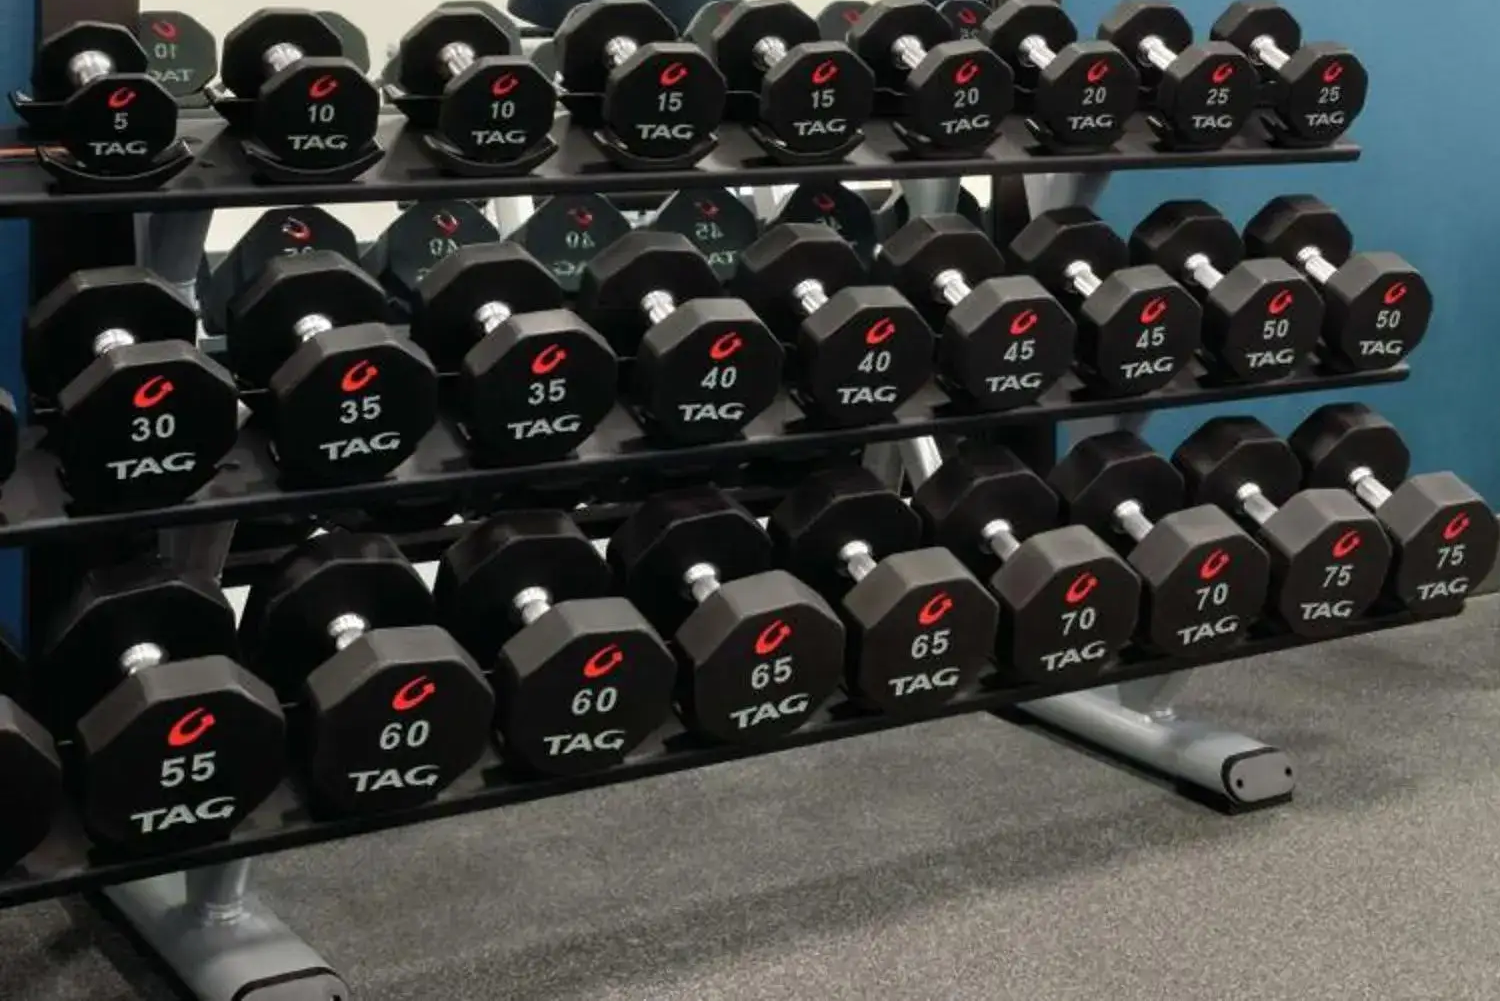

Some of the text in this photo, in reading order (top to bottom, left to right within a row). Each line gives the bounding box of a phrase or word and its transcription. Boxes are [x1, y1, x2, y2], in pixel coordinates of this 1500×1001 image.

[658, 91, 683, 112] 15
[811, 88, 835, 109] 15
[954, 86, 980, 109] 20
[1082, 86, 1107, 106] 20
[1205, 87, 1231, 106] 25
[1317, 85, 1341, 104] 25
[113, 112, 129, 130] 5
[308, 103, 335, 123] 10
[491, 100, 516, 120] 10
[1191, 114, 1233, 129] TAG
[1305, 110, 1345, 127] TAG
[636, 123, 693, 140] TAG
[793, 118, 847, 136] TAG
[940, 114, 991, 135] TAG
[1068, 114, 1113, 130] TAG
[88, 140, 148, 156] TAG
[287, 134, 348, 150] TAG
[471, 130, 526, 146] TAG
[1263, 318, 1290, 340] 50
[1375, 309, 1401, 329] 50
[1135, 326, 1166, 349] 45
[1359, 340, 1403, 355] TAG
[857, 350, 891, 373] 40
[1003, 339, 1036, 362] 45
[1246, 348, 1294, 368] TAG
[700, 366, 737, 390] 40
[1120, 356, 1173, 379] TAG
[527, 378, 566, 406] 35
[985, 372, 1042, 392] TAG
[837, 385, 897, 404] TAG
[339, 394, 381, 424] 35
[678, 402, 744, 422] TAG
[131, 413, 175, 442] 30
[507, 414, 581, 440] TAG
[319, 431, 401, 461] TAG
[107, 452, 196, 480] TAG
[1437, 544, 1466, 569] 75
[1322, 564, 1354, 588] 75
[1196, 582, 1229, 611] 70
[1416, 577, 1469, 601] TAG
[1061, 606, 1096, 636] 70
[1300, 600, 1353, 620] TAG
[1177, 615, 1238, 645] TAG
[911, 629, 951, 659] 65
[1040, 640, 1106, 672] TAG
[751, 656, 793, 690] 65
[888, 667, 961, 698] TAG
[571, 686, 617, 715] 60
[730, 693, 808, 730] TAG
[379, 719, 430, 750] 60
[543, 729, 626, 755] TAG
[159, 750, 217, 788] 55
[348, 764, 439, 793] TAG
[130, 796, 235, 833] TAG
